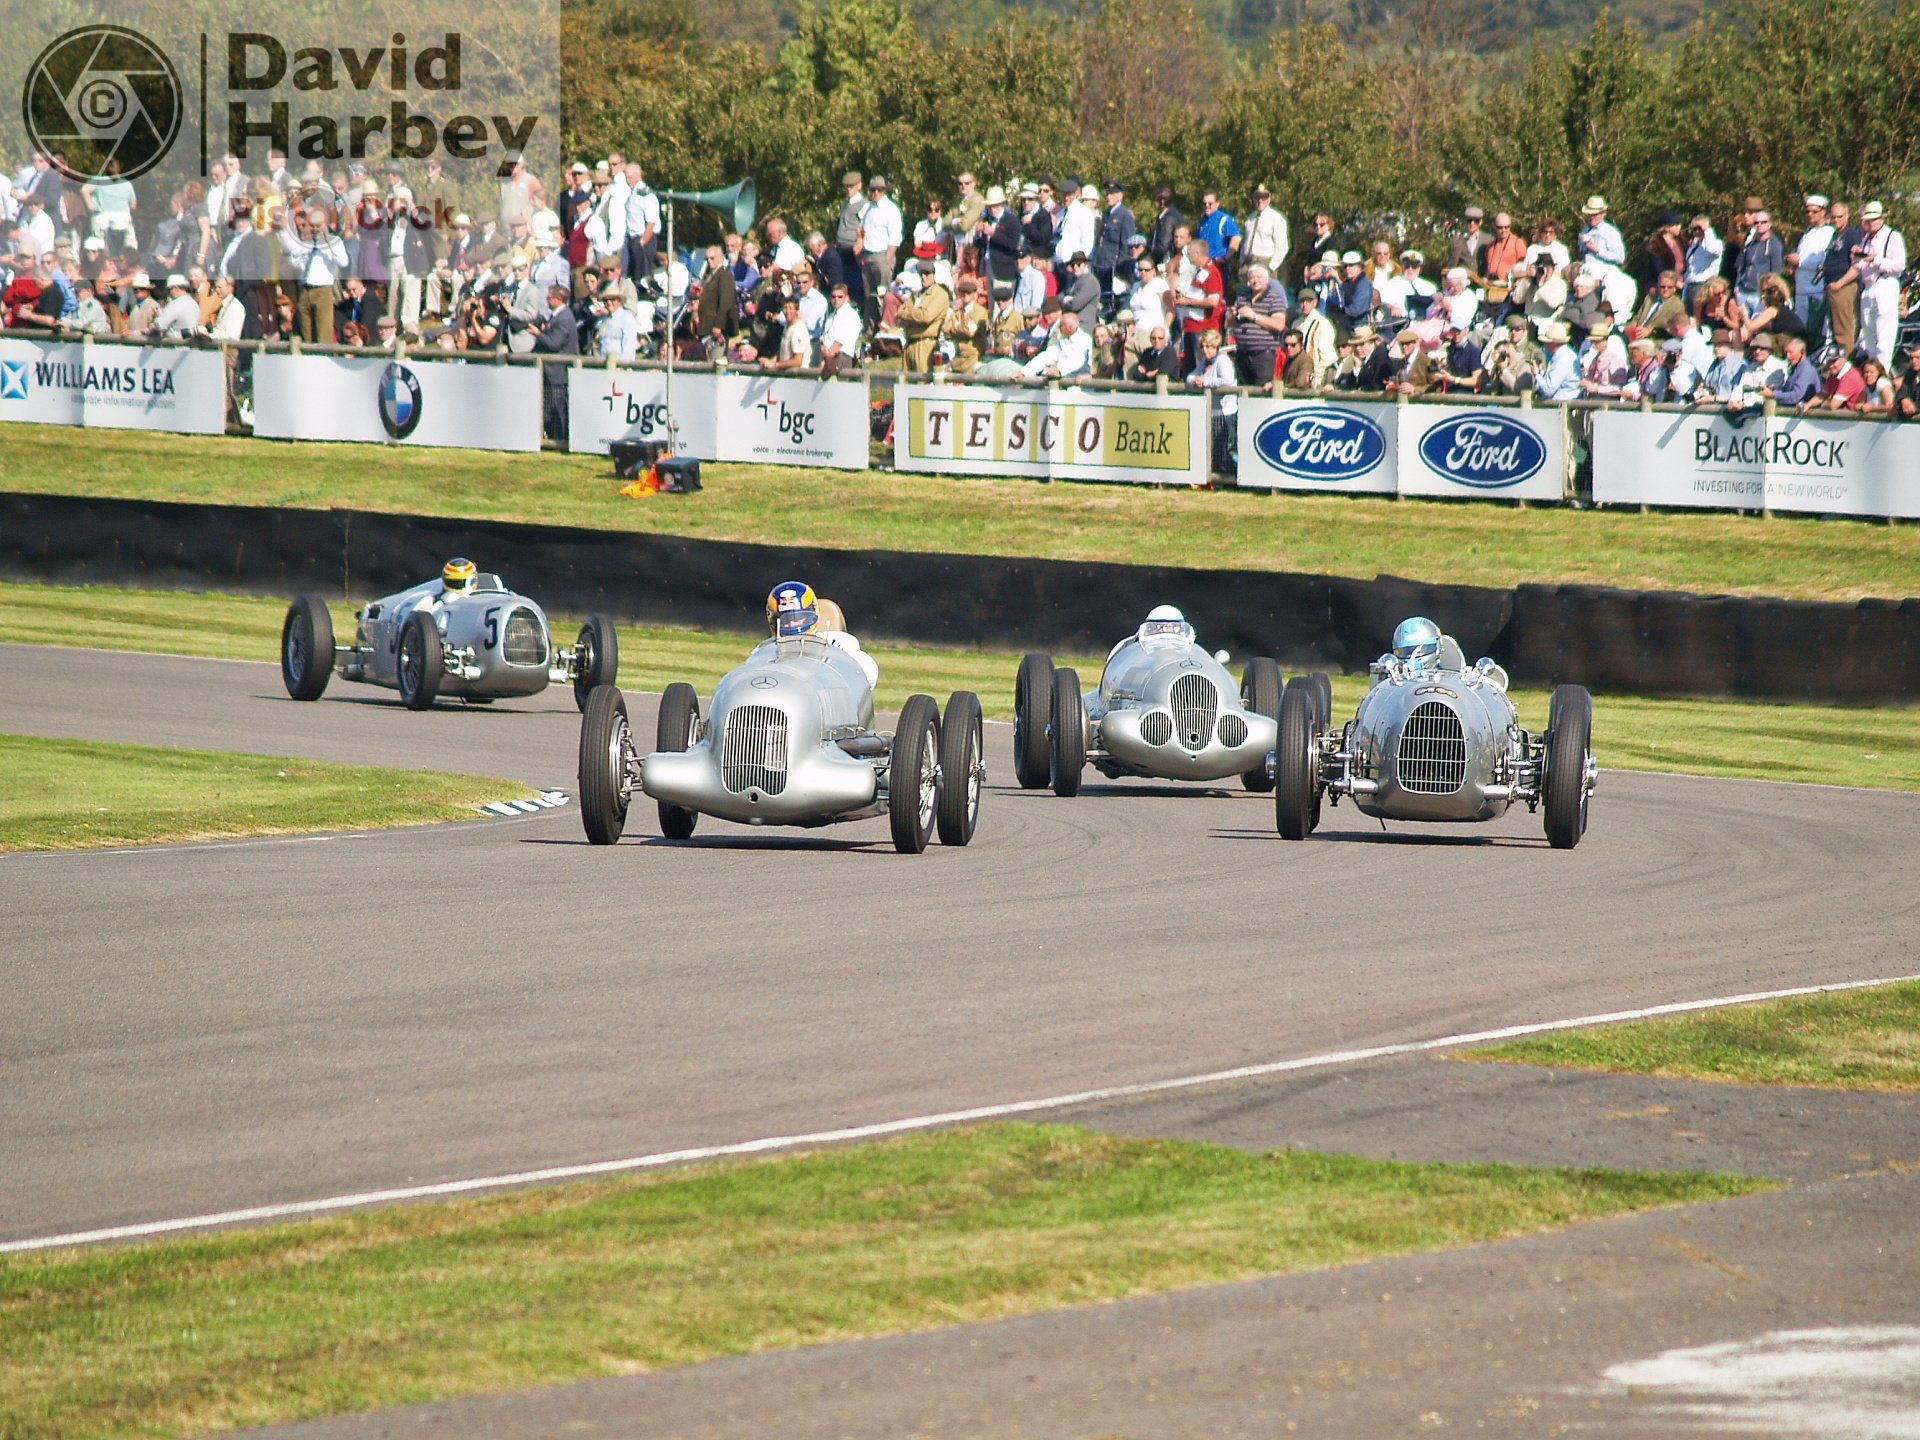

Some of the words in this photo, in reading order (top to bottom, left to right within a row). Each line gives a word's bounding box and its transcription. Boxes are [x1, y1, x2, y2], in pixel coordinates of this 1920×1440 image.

[36, 362, 135, 392] WILLIAMS
[142, 368, 176, 394] LEA
[626, 394, 667, 434] bgc
[779, 402, 814, 444] bgc
[928, 411, 1101, 454] TESCO
[1115, 420, 1173, 455] Bank
[752, 446, 770, 454] voice
[776, 446, 805, 457] electronic
[805, 448, 834, 460] brokerage
[1279, 416, 1366, 465] Ford
[1446, 422, 1520, 472] Ford
[1694, 480, 1744, 495] INVESTING
[1745, 481, 1763, 496] FOR
[1767, 483, 1775, 493] A
[1777, 483, 1806, 497] NEW
[484, 607, 501, 650] 5
